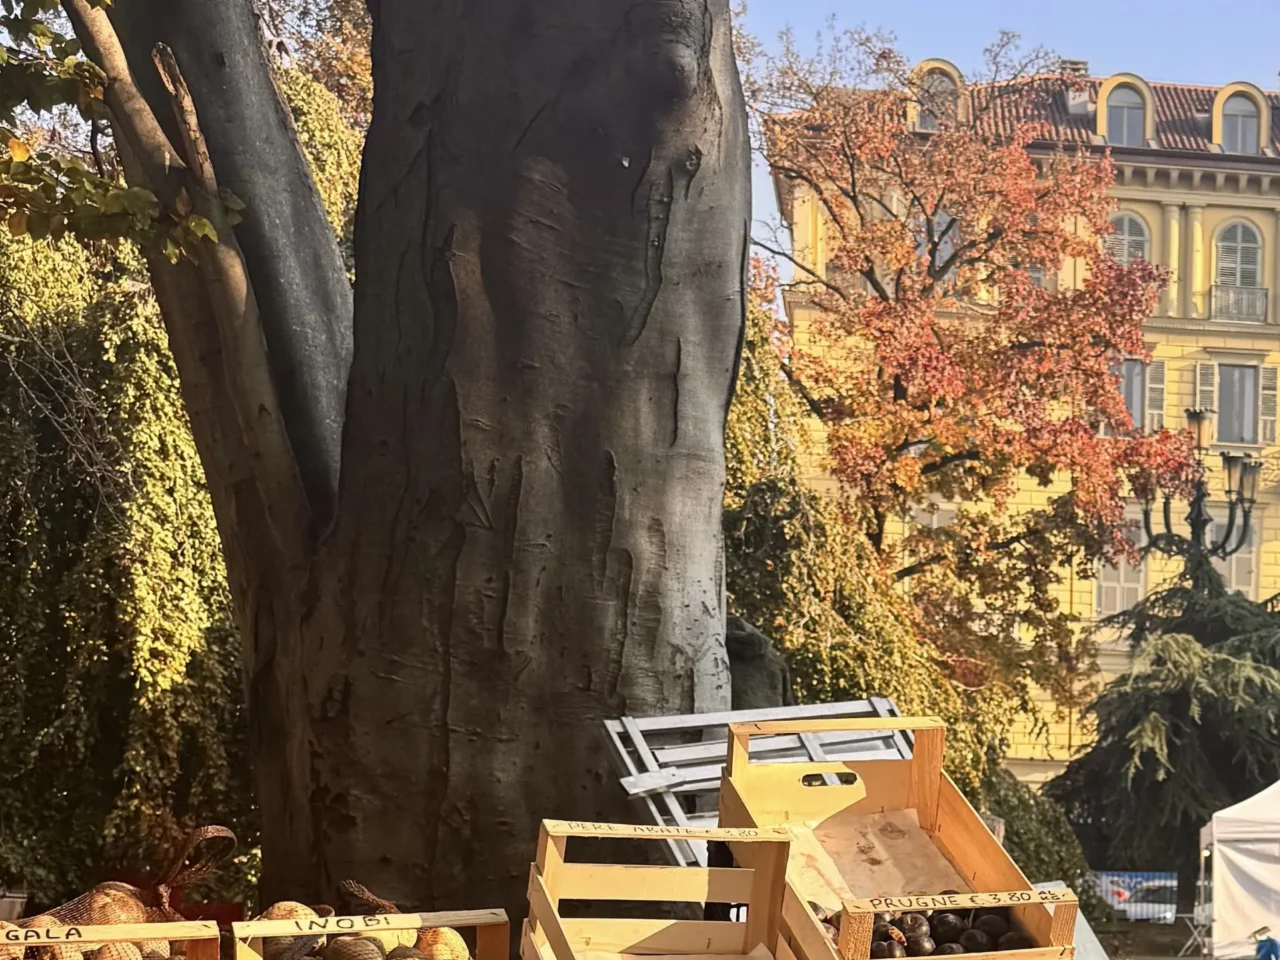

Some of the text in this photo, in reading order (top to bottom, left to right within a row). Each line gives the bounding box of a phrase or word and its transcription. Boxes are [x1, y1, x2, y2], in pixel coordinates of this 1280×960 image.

[869, 895, 958, 910] PRUGNE
[989, 892, 1031, 904] 3.80
[5, 927, 83, 941] GALA
